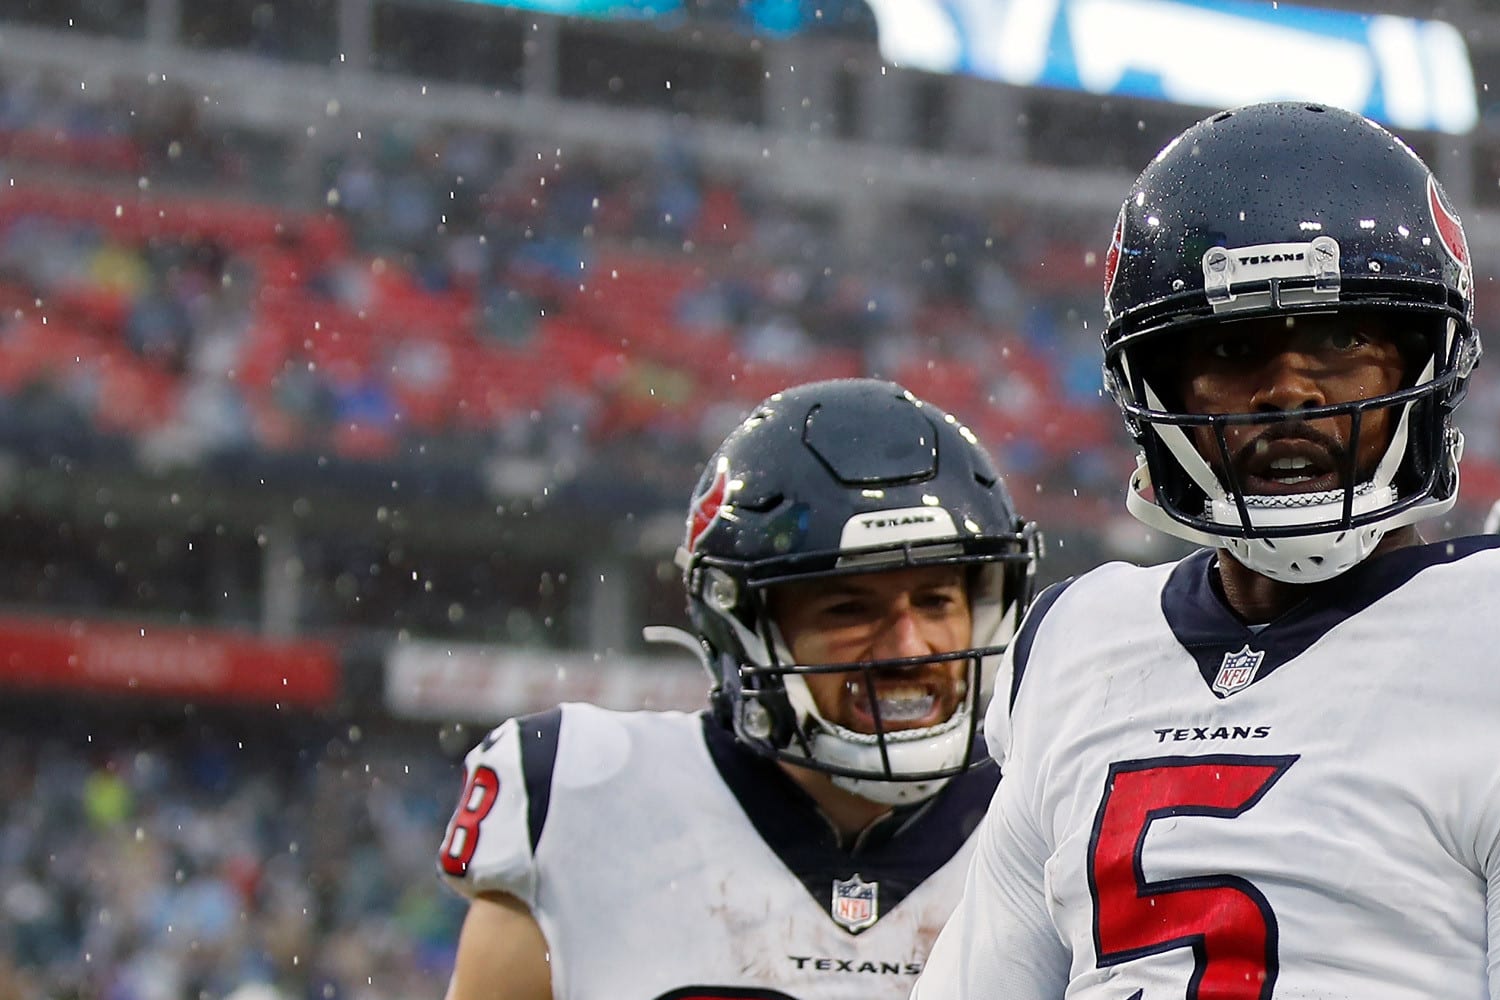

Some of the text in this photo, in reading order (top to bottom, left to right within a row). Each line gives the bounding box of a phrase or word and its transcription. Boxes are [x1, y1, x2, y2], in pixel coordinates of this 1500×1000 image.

[1238, 253, 1305, 266] TEXANS
[1219, 669, 1248, 687] NFL
[1153, 726, 1272, 743] TEXANS
[440, 764, 500, 876] 8
[838, 898, 869, 921] NFL
[788, 955, 922, 975] TEXANS
